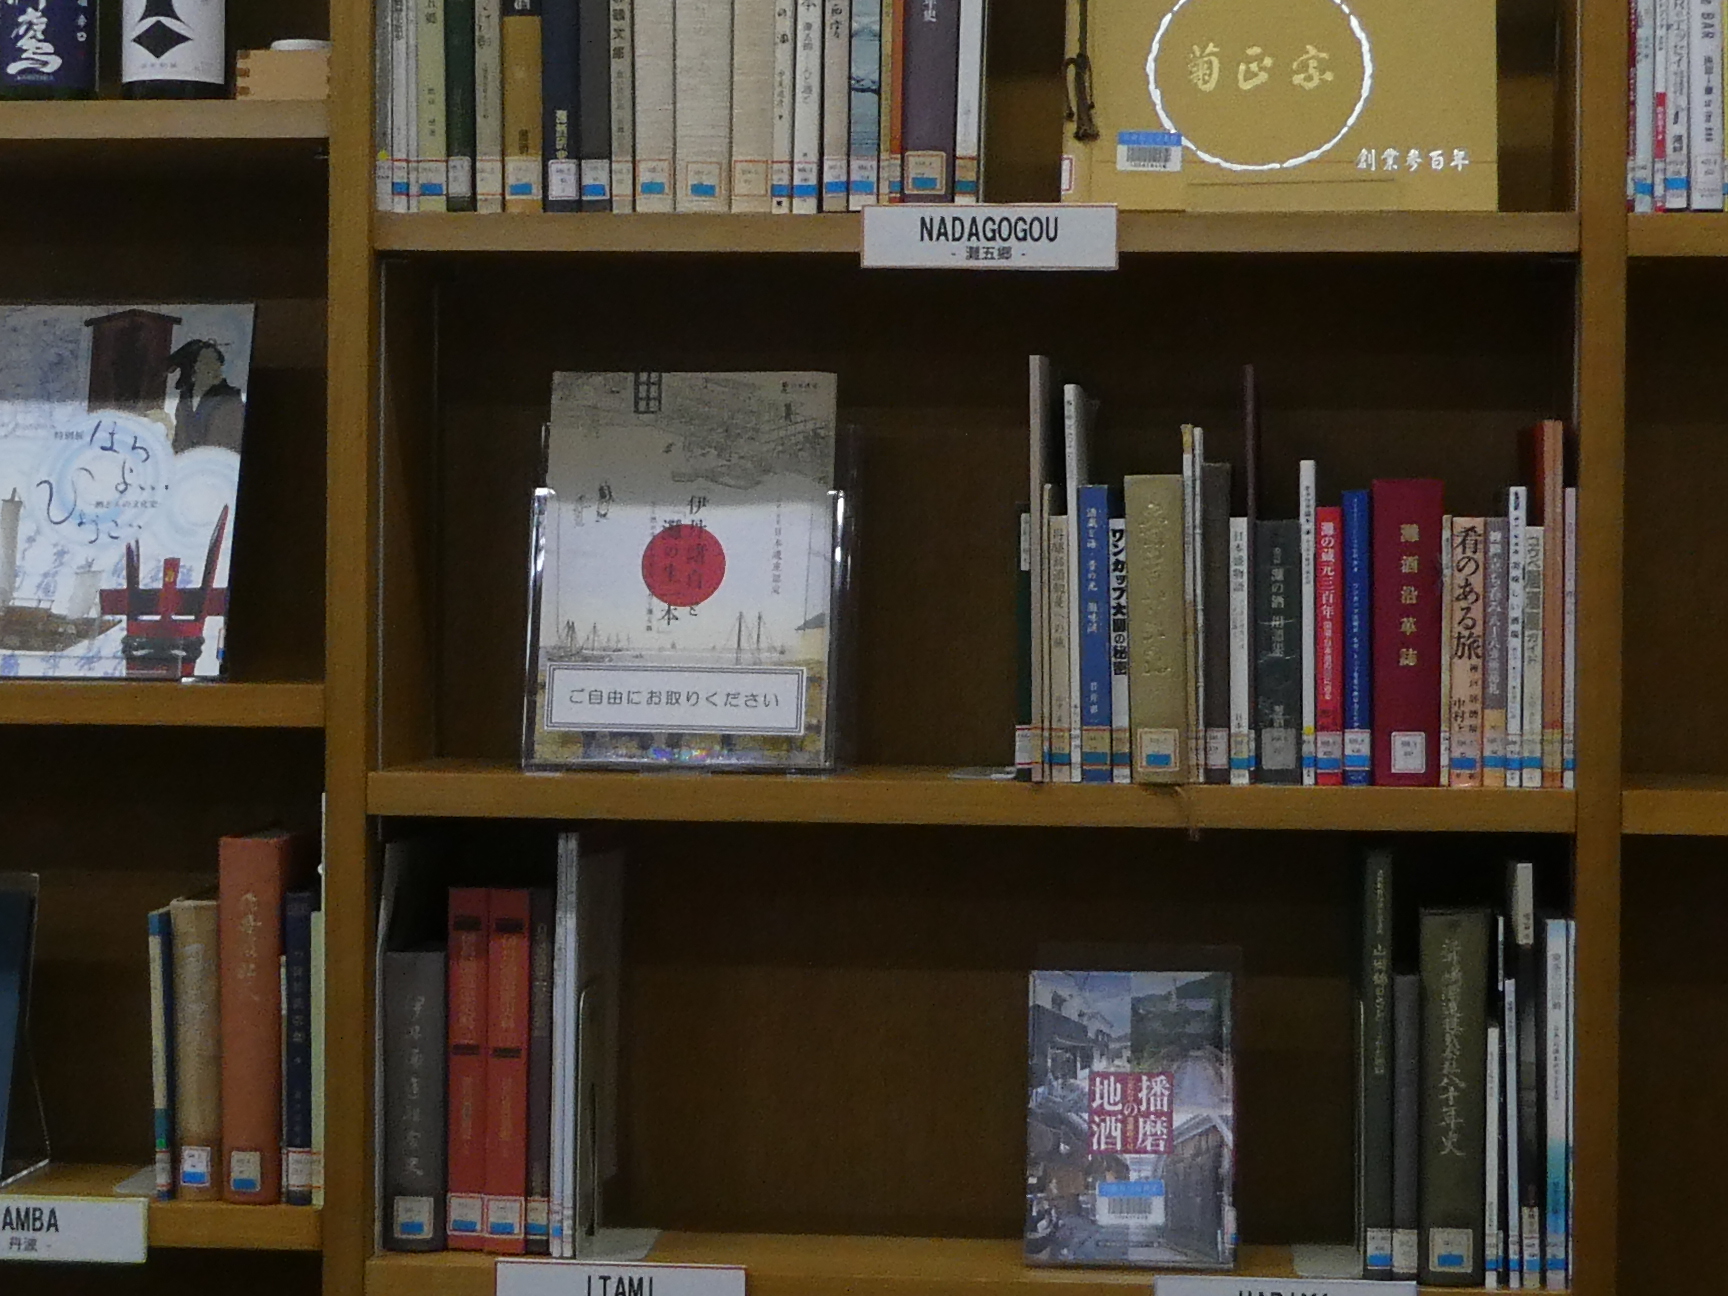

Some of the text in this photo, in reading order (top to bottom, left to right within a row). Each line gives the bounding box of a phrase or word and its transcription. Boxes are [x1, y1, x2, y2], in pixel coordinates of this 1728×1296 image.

[1187, 42, 1335, 93] 菊正宗
[918, 214, 1059, 244] NADAGOGOU
[1453, 525, 1483, 661] 肴のある旅
[568, 688, 781, 709] ご自由にお取りください
[1091, 1074, 1171, 1152] 播磨 の 地酒
[8, 1236, 39, 1253] 丹波
